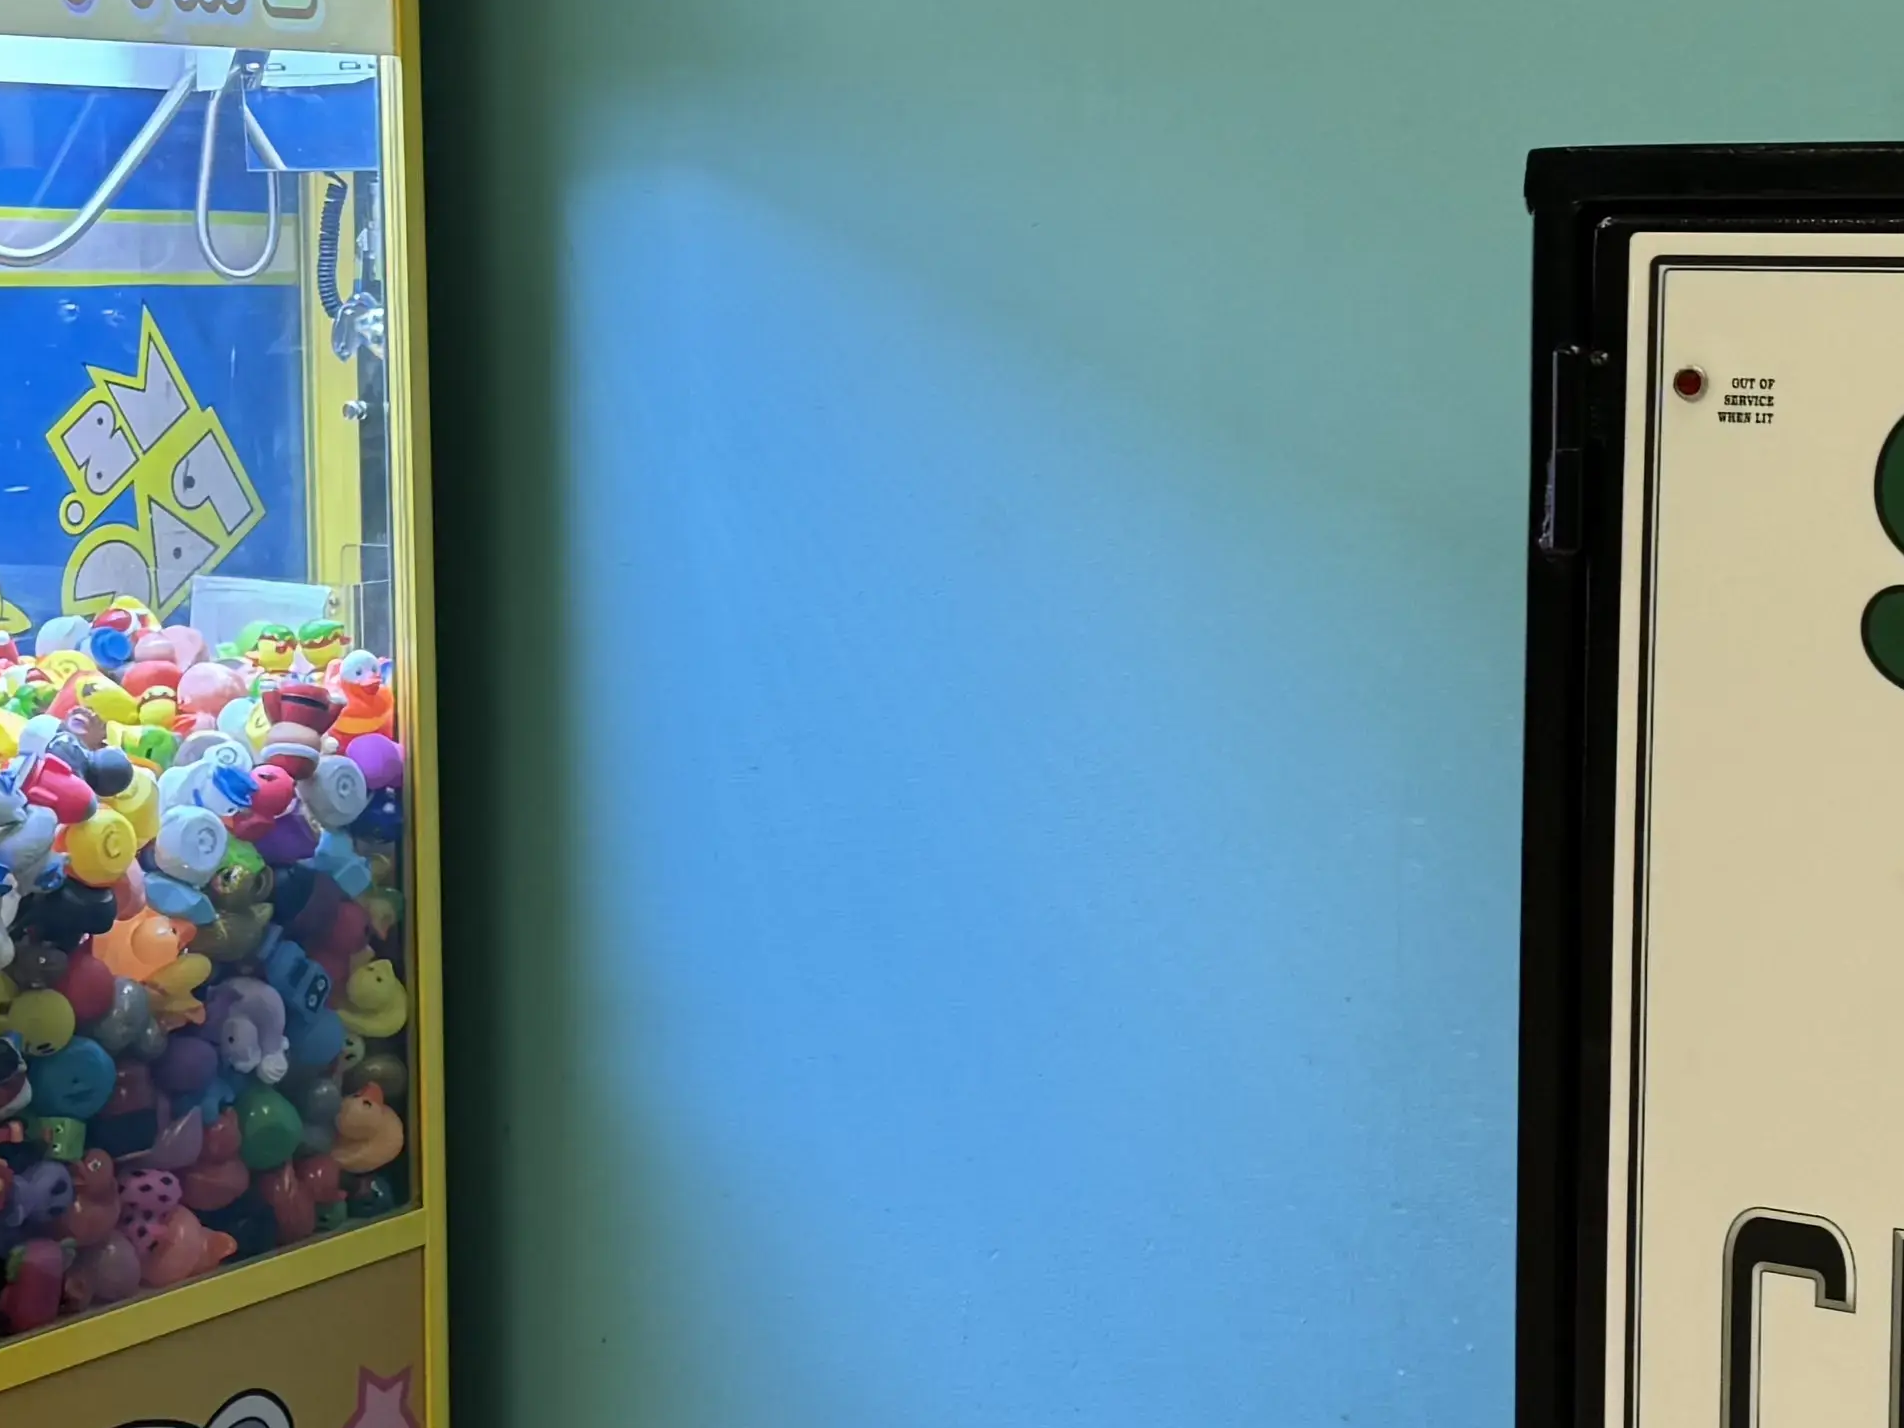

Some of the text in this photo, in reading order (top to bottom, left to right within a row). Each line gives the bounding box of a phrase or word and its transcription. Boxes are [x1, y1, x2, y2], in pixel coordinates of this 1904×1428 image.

[1732, 377, 1775, 390] OUT OF
[1724, 394, 1774, 406] SERVICE
[1717, 411, 1774, 424] WHEN LIT
